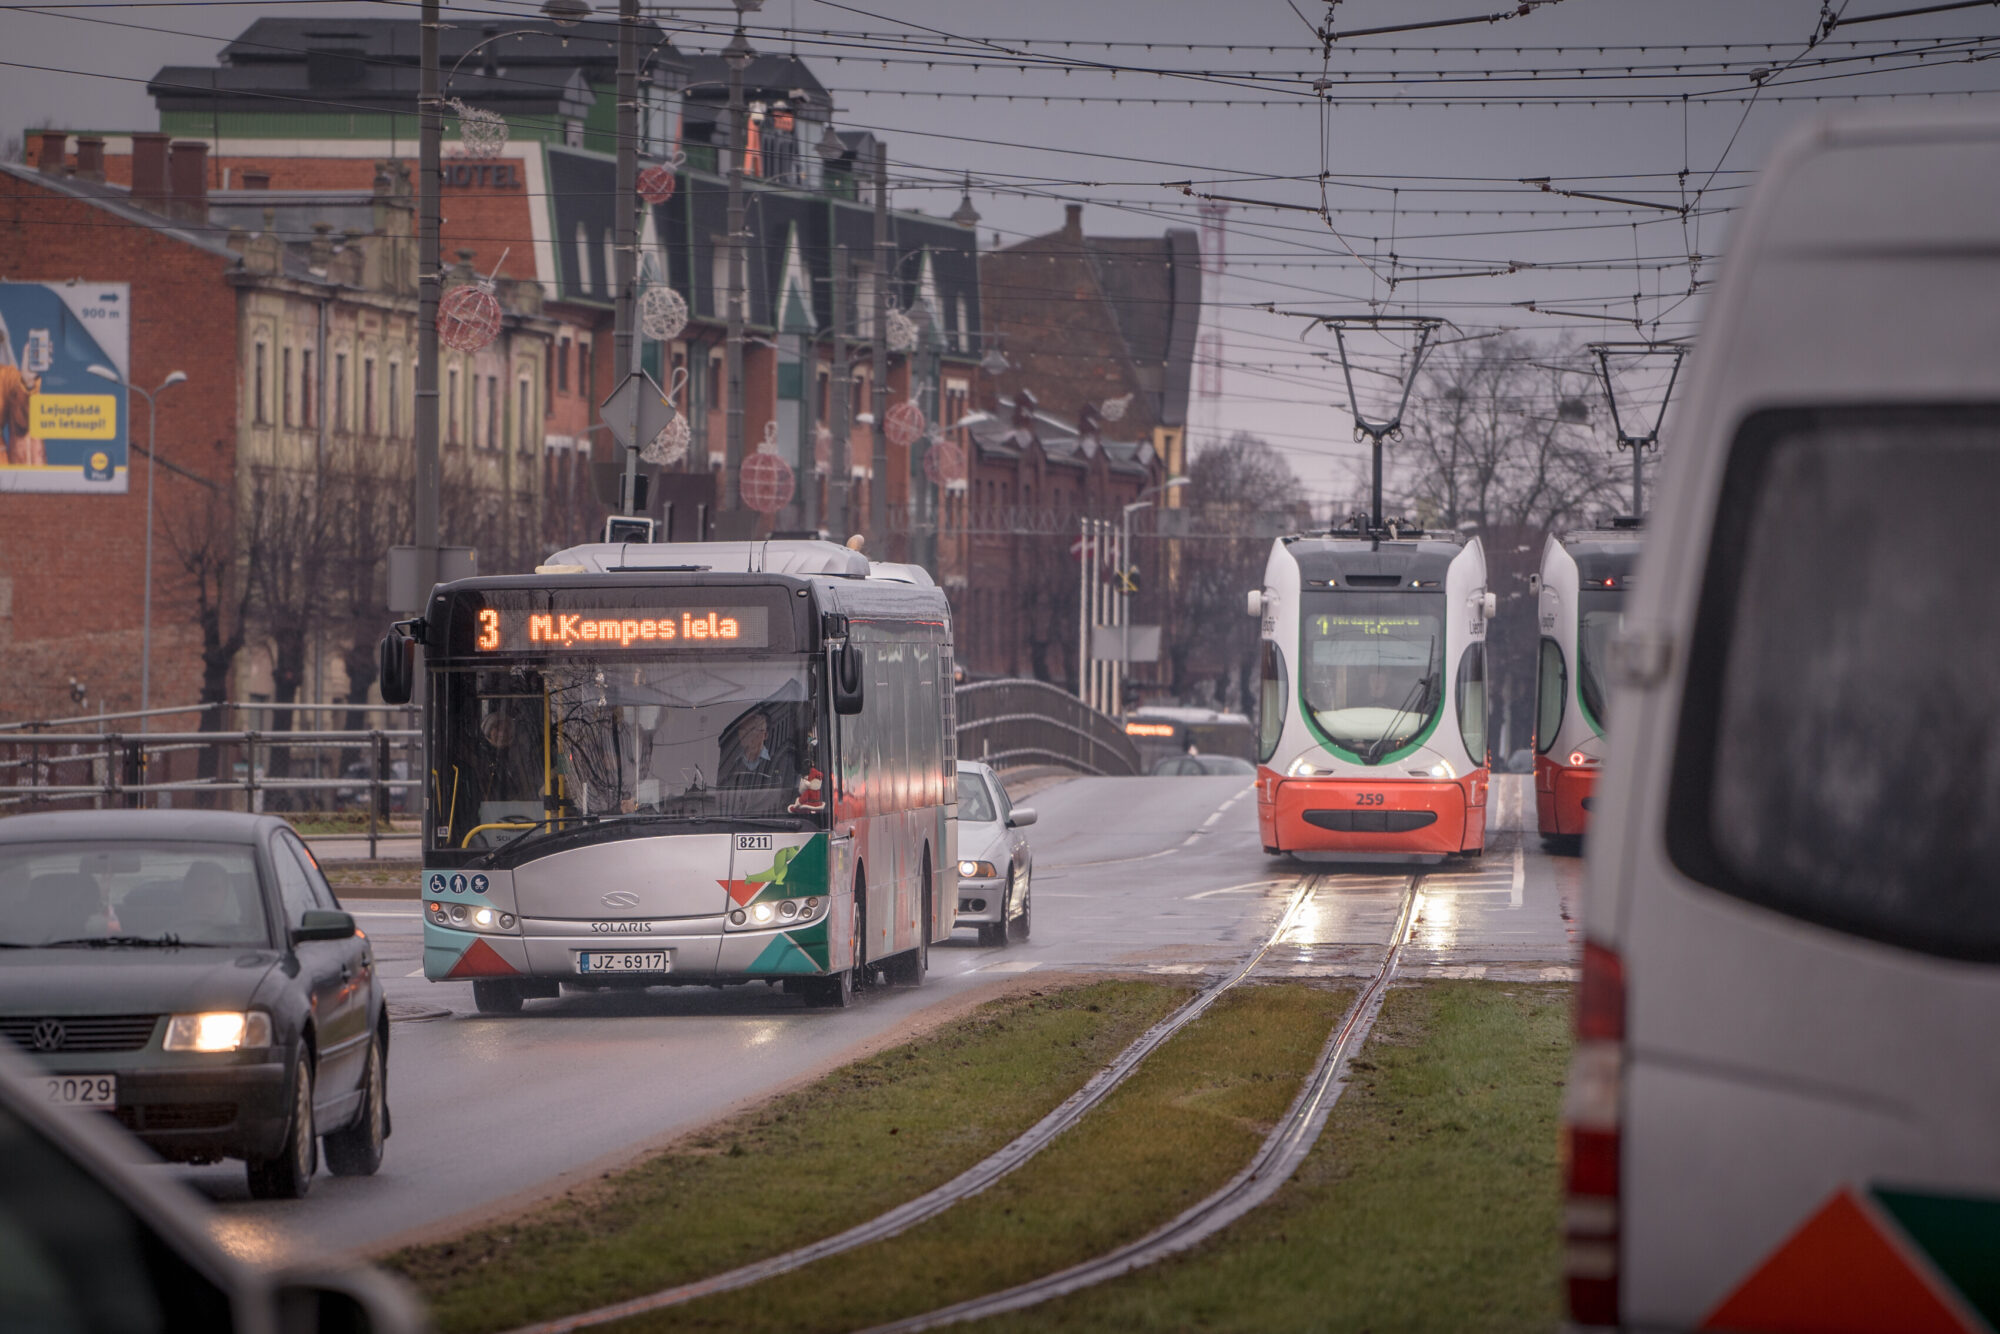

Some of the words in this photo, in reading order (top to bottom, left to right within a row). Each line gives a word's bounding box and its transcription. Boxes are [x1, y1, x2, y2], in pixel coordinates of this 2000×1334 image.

[82, 308, 106, 319] 900
[109, 311, 120, 319] m
[40, 420, 56, 429] un
[478, 609, 499, 649] 3
[530, 613, 676, 647] M.Ķempes
[682, 611, 739, 639] iela
[1356, 793, 1385, 806] 259
[740, 836, 769, 848] 8211
[591, 922, 652, 933] SOLARIS
[47, 1079, 111, 1103] 2029
